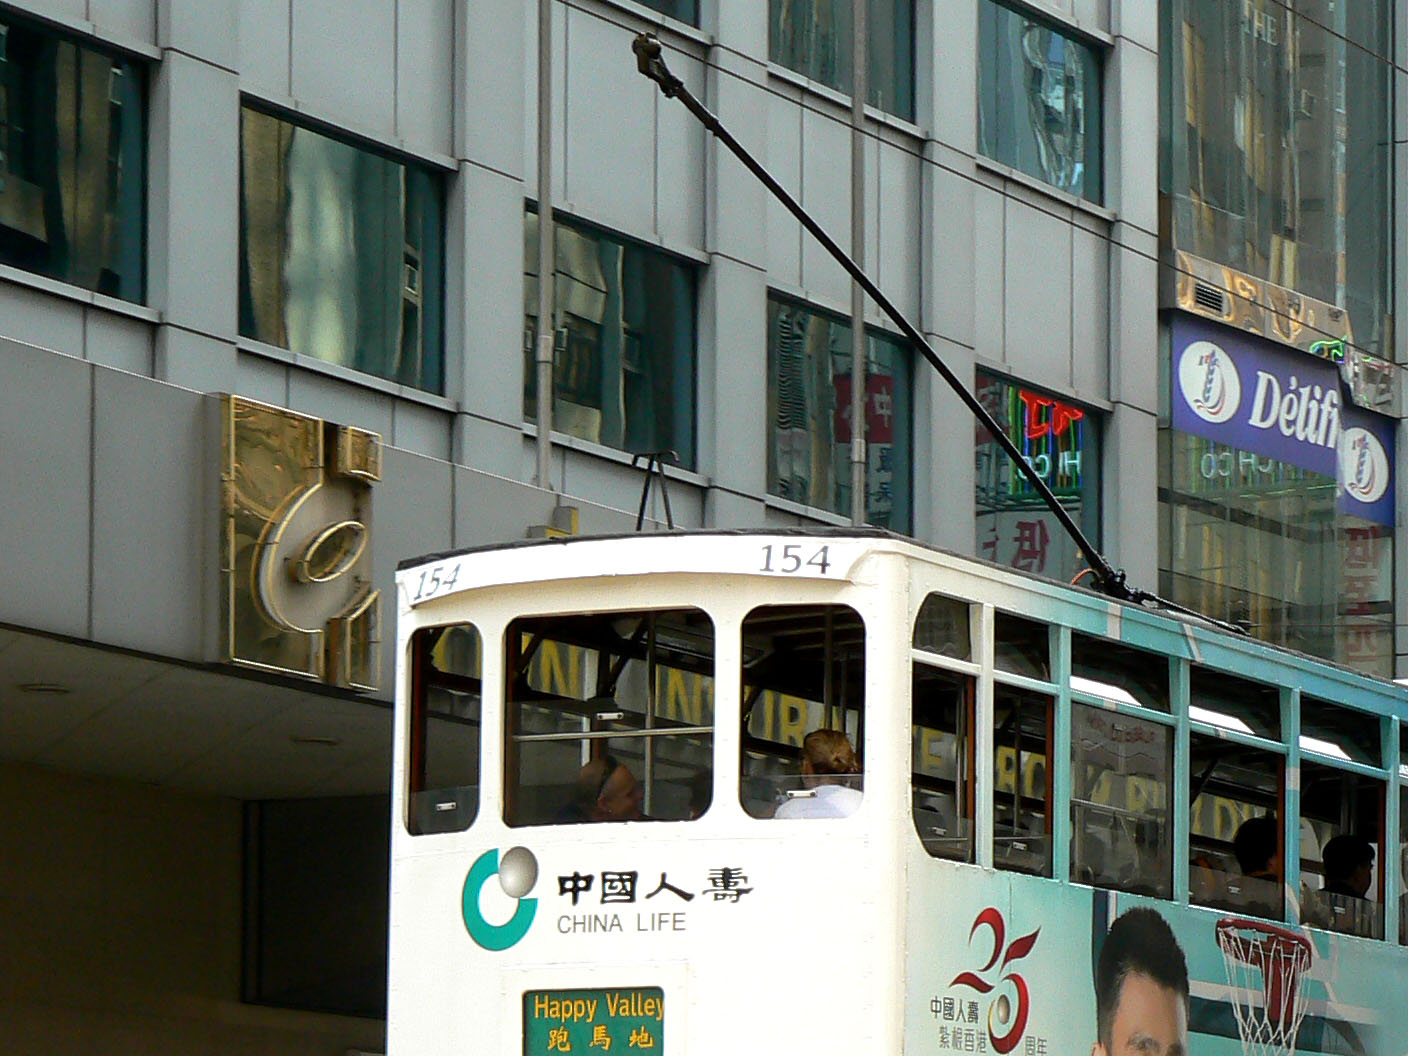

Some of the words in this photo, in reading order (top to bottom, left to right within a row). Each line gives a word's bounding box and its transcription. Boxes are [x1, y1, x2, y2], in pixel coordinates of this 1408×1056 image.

[758, 544, 832, 575] 154
[412, 562, 462, 601] 154
[557, 866, 755, 906] 中國人壽
[557, 913, 623, 934] CHINA
[636, 912, 686, 932] LIFE
[535, 993, 598, 1023] Happy
[606, 991, 664, 1022] Valley
[547, 1024, 655, 1053] 跑馬地
